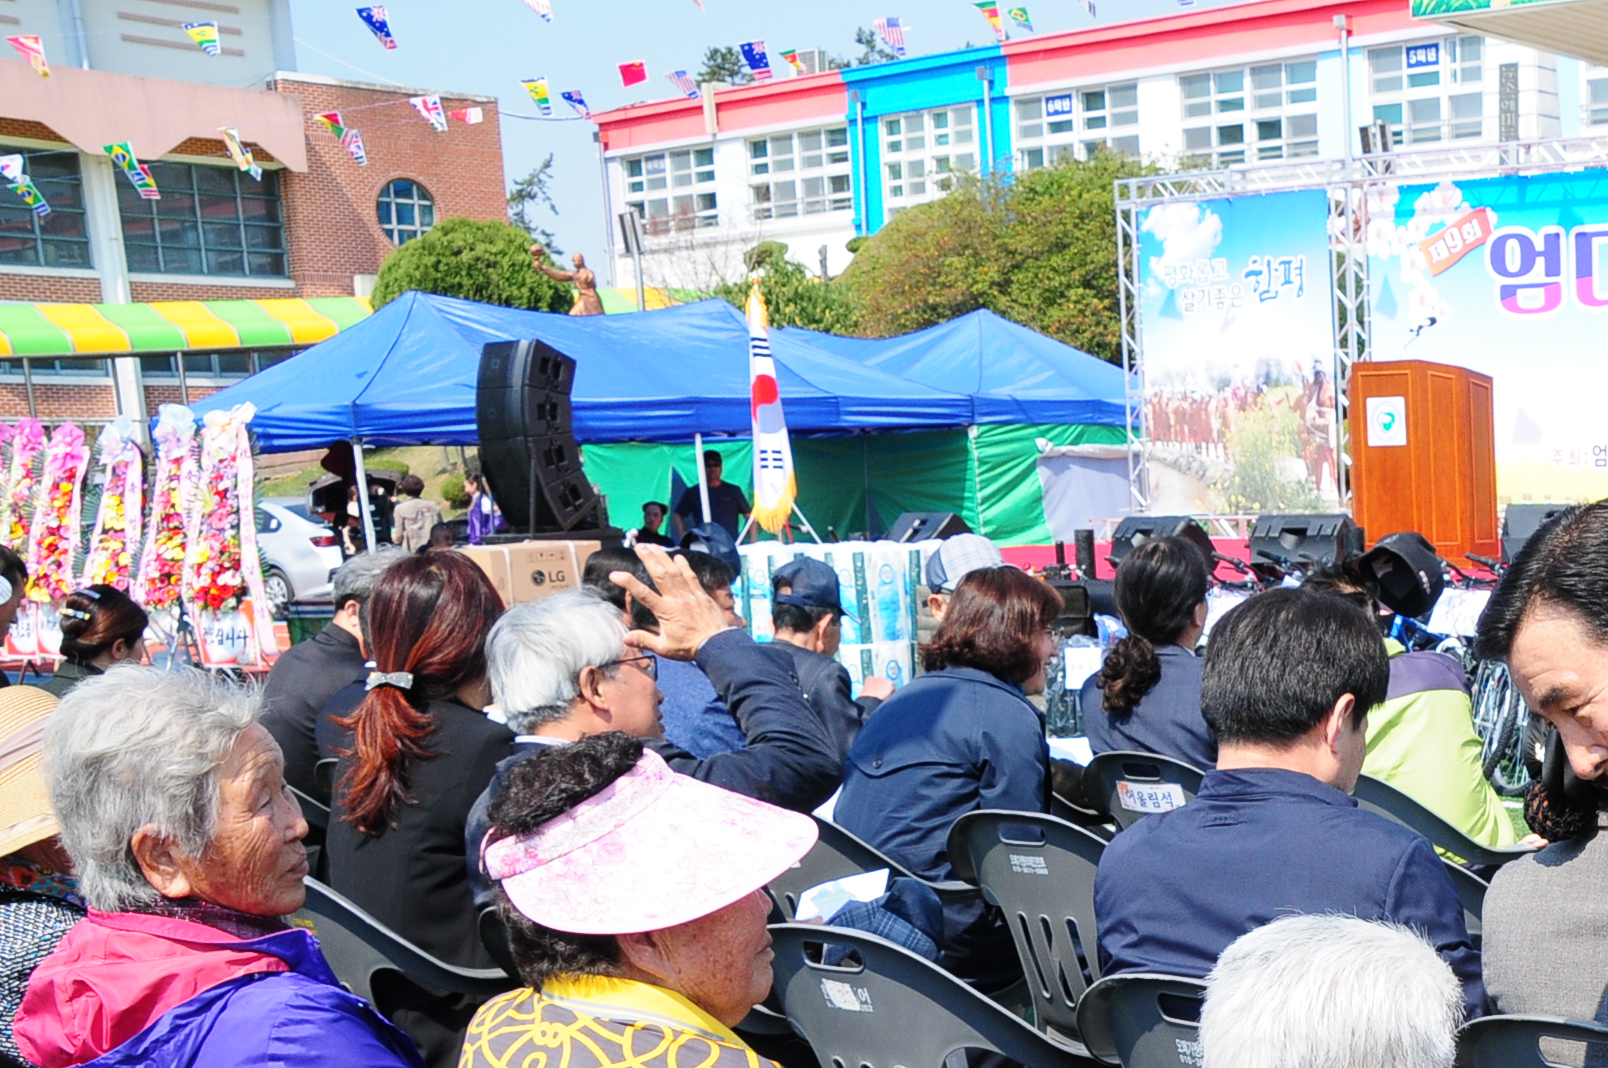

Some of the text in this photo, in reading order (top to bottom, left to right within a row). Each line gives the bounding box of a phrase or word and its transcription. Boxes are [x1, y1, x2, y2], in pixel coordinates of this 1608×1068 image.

[1427, 217, 1483, 265] 제9회
[1164, 260, 1227, 288] 평화롭고
[1181, 284, 1244, 312] 살기좋은
[548, 570, 566, 583] LG
[1125, 790, 1174, 808] 어울림석
